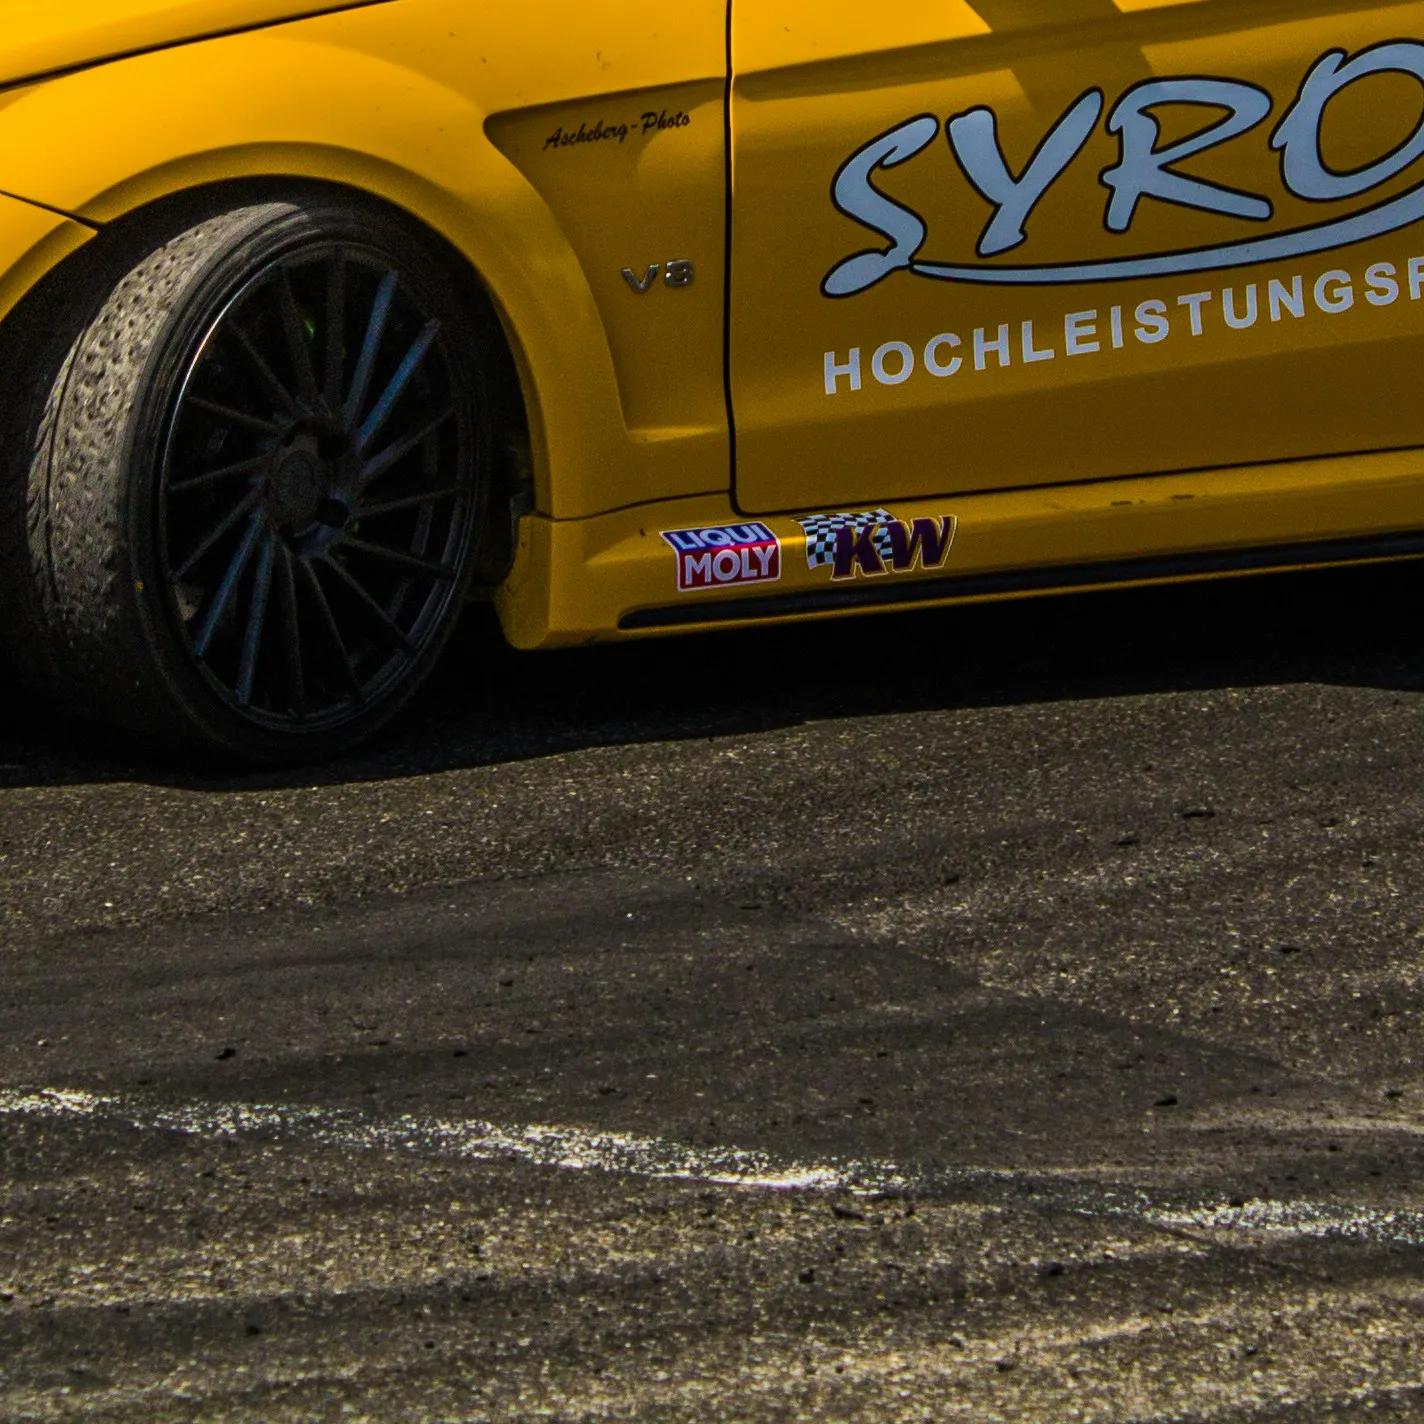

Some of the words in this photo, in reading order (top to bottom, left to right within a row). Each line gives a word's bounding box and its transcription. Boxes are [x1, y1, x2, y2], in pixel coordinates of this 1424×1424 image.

[620, 258, 693, 293] V8
[670, 521, 774, 551] LIQUI
[829, 514, 958, 582] KW
[683, 543, 777, 586] MOLY
